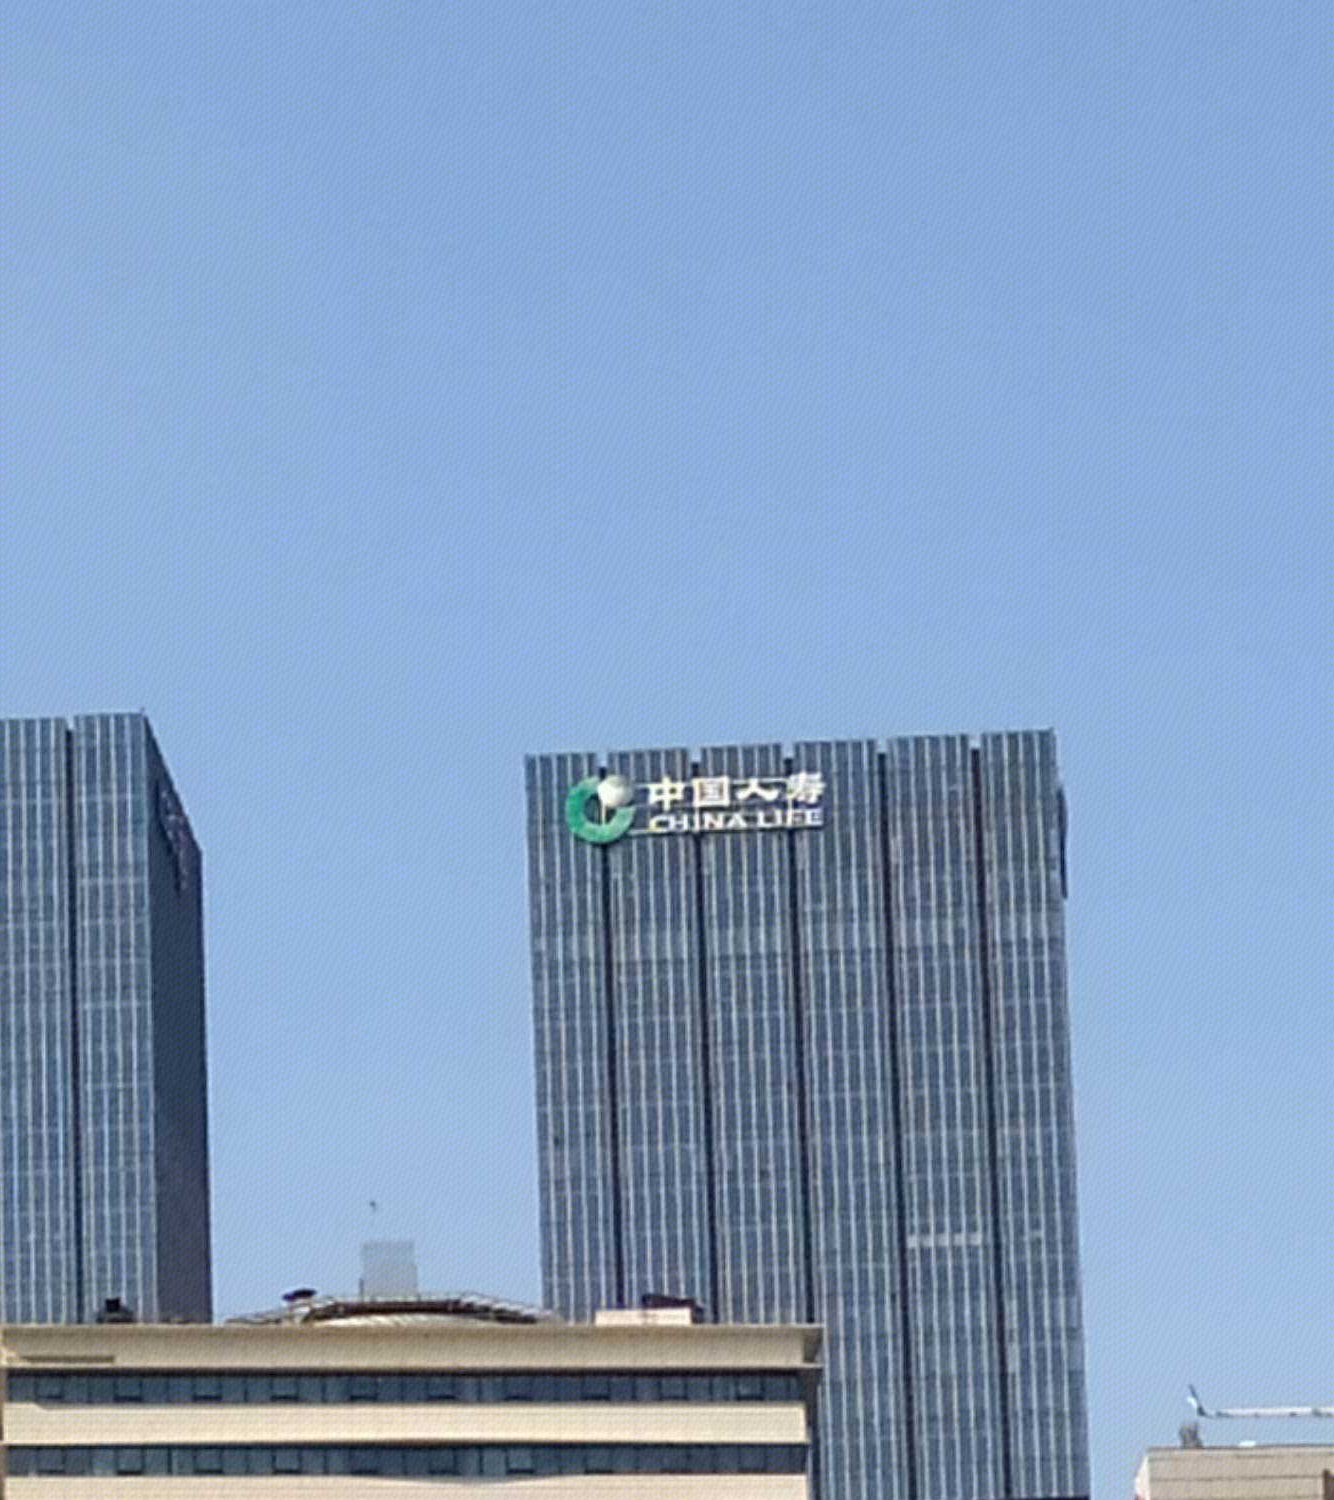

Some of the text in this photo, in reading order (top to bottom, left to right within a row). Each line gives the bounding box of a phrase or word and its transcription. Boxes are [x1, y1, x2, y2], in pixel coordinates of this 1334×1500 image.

[647, 771, 826, 810] 中国人寿
[649, 807, 824, 833] CHINA LIFE
